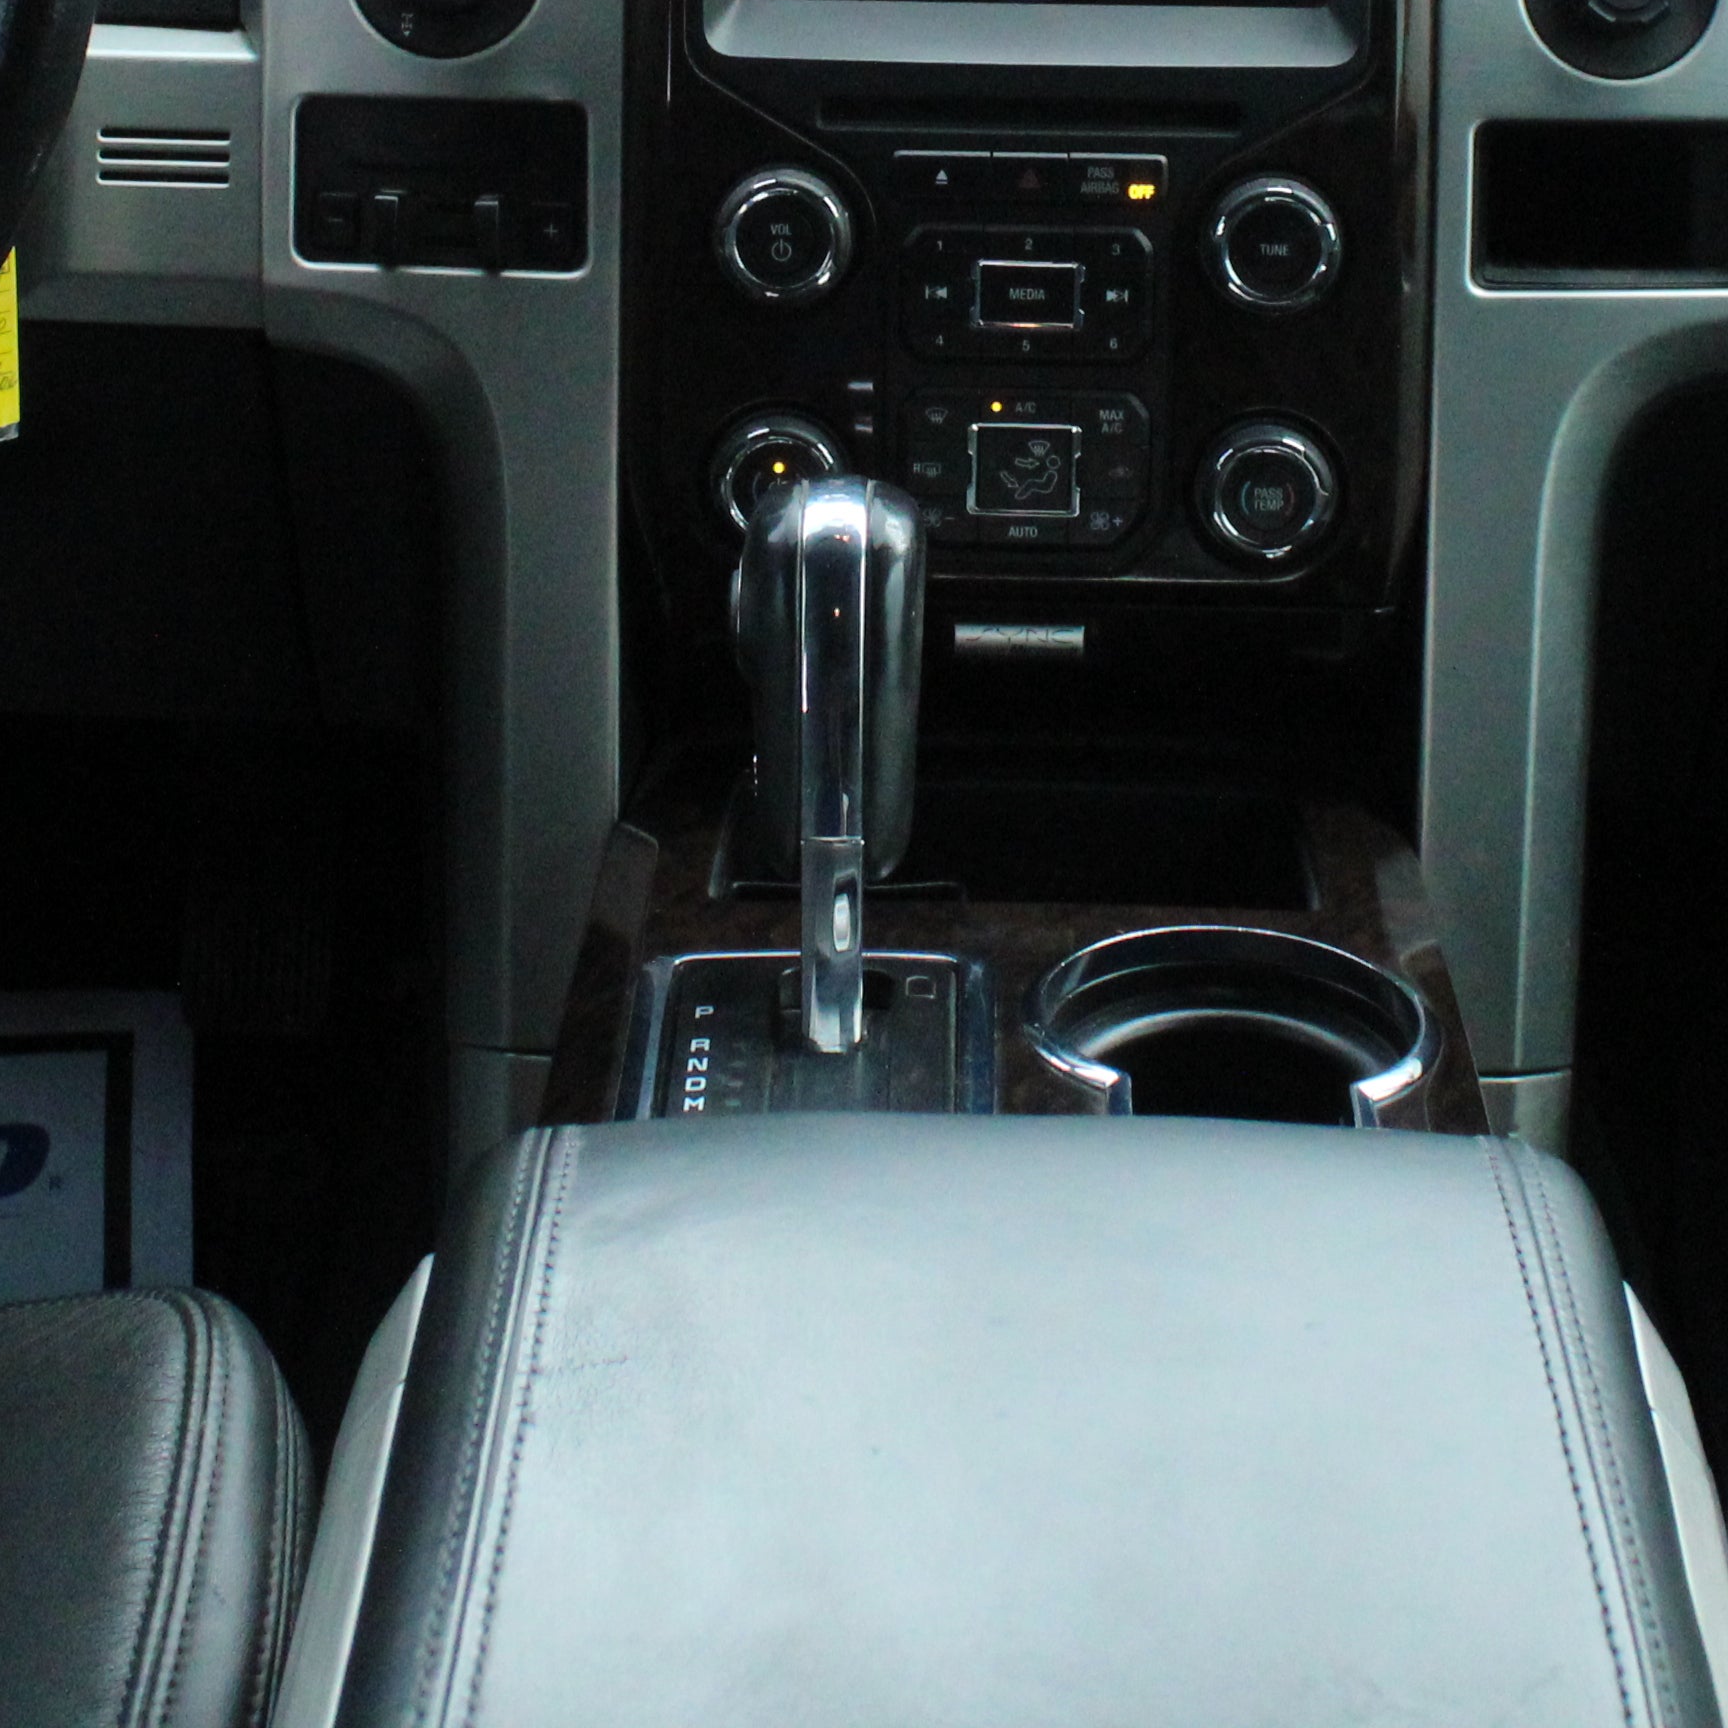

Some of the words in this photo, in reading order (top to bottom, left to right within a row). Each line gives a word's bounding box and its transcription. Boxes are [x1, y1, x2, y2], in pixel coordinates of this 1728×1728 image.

[1087, 166, 1115, 180] PASS
[1080, 181, 1120, 195] AIRBAG
[1127, 184, 1156, 201] OFF
[770, 223, 793, 237] VOL
[936, 240, 943, 252] 1
[1024, 238, 1033, 251] 2
[1112, 243, 1121, 256] 3
[1259, 244, 1290, 257] TUNE
[1009, 287, 1046, 301] MEDIA
[935, 334, 944, 347] 4
[1022, 339, 1030, 352] 5
[1109, 337, 1118, 350] 6
[1015, 401, 1037, 414] A/C
[1099, 410, 1125, 421] MAX
[1101, 422, 1124, 434] A/C
[1253, 487, 1284, 499] PASS
[1253, 500, 1285, 512] TEMP
[1008, 525, 1039, 538] AUTO
[694, 1004, 716, 1019] P
[689, 1037, 711, 1053] R
[686, 1057, 709, 1073] N
[684, 1076, 707, 1093] D
[682, 1096, 706, 1113] M
